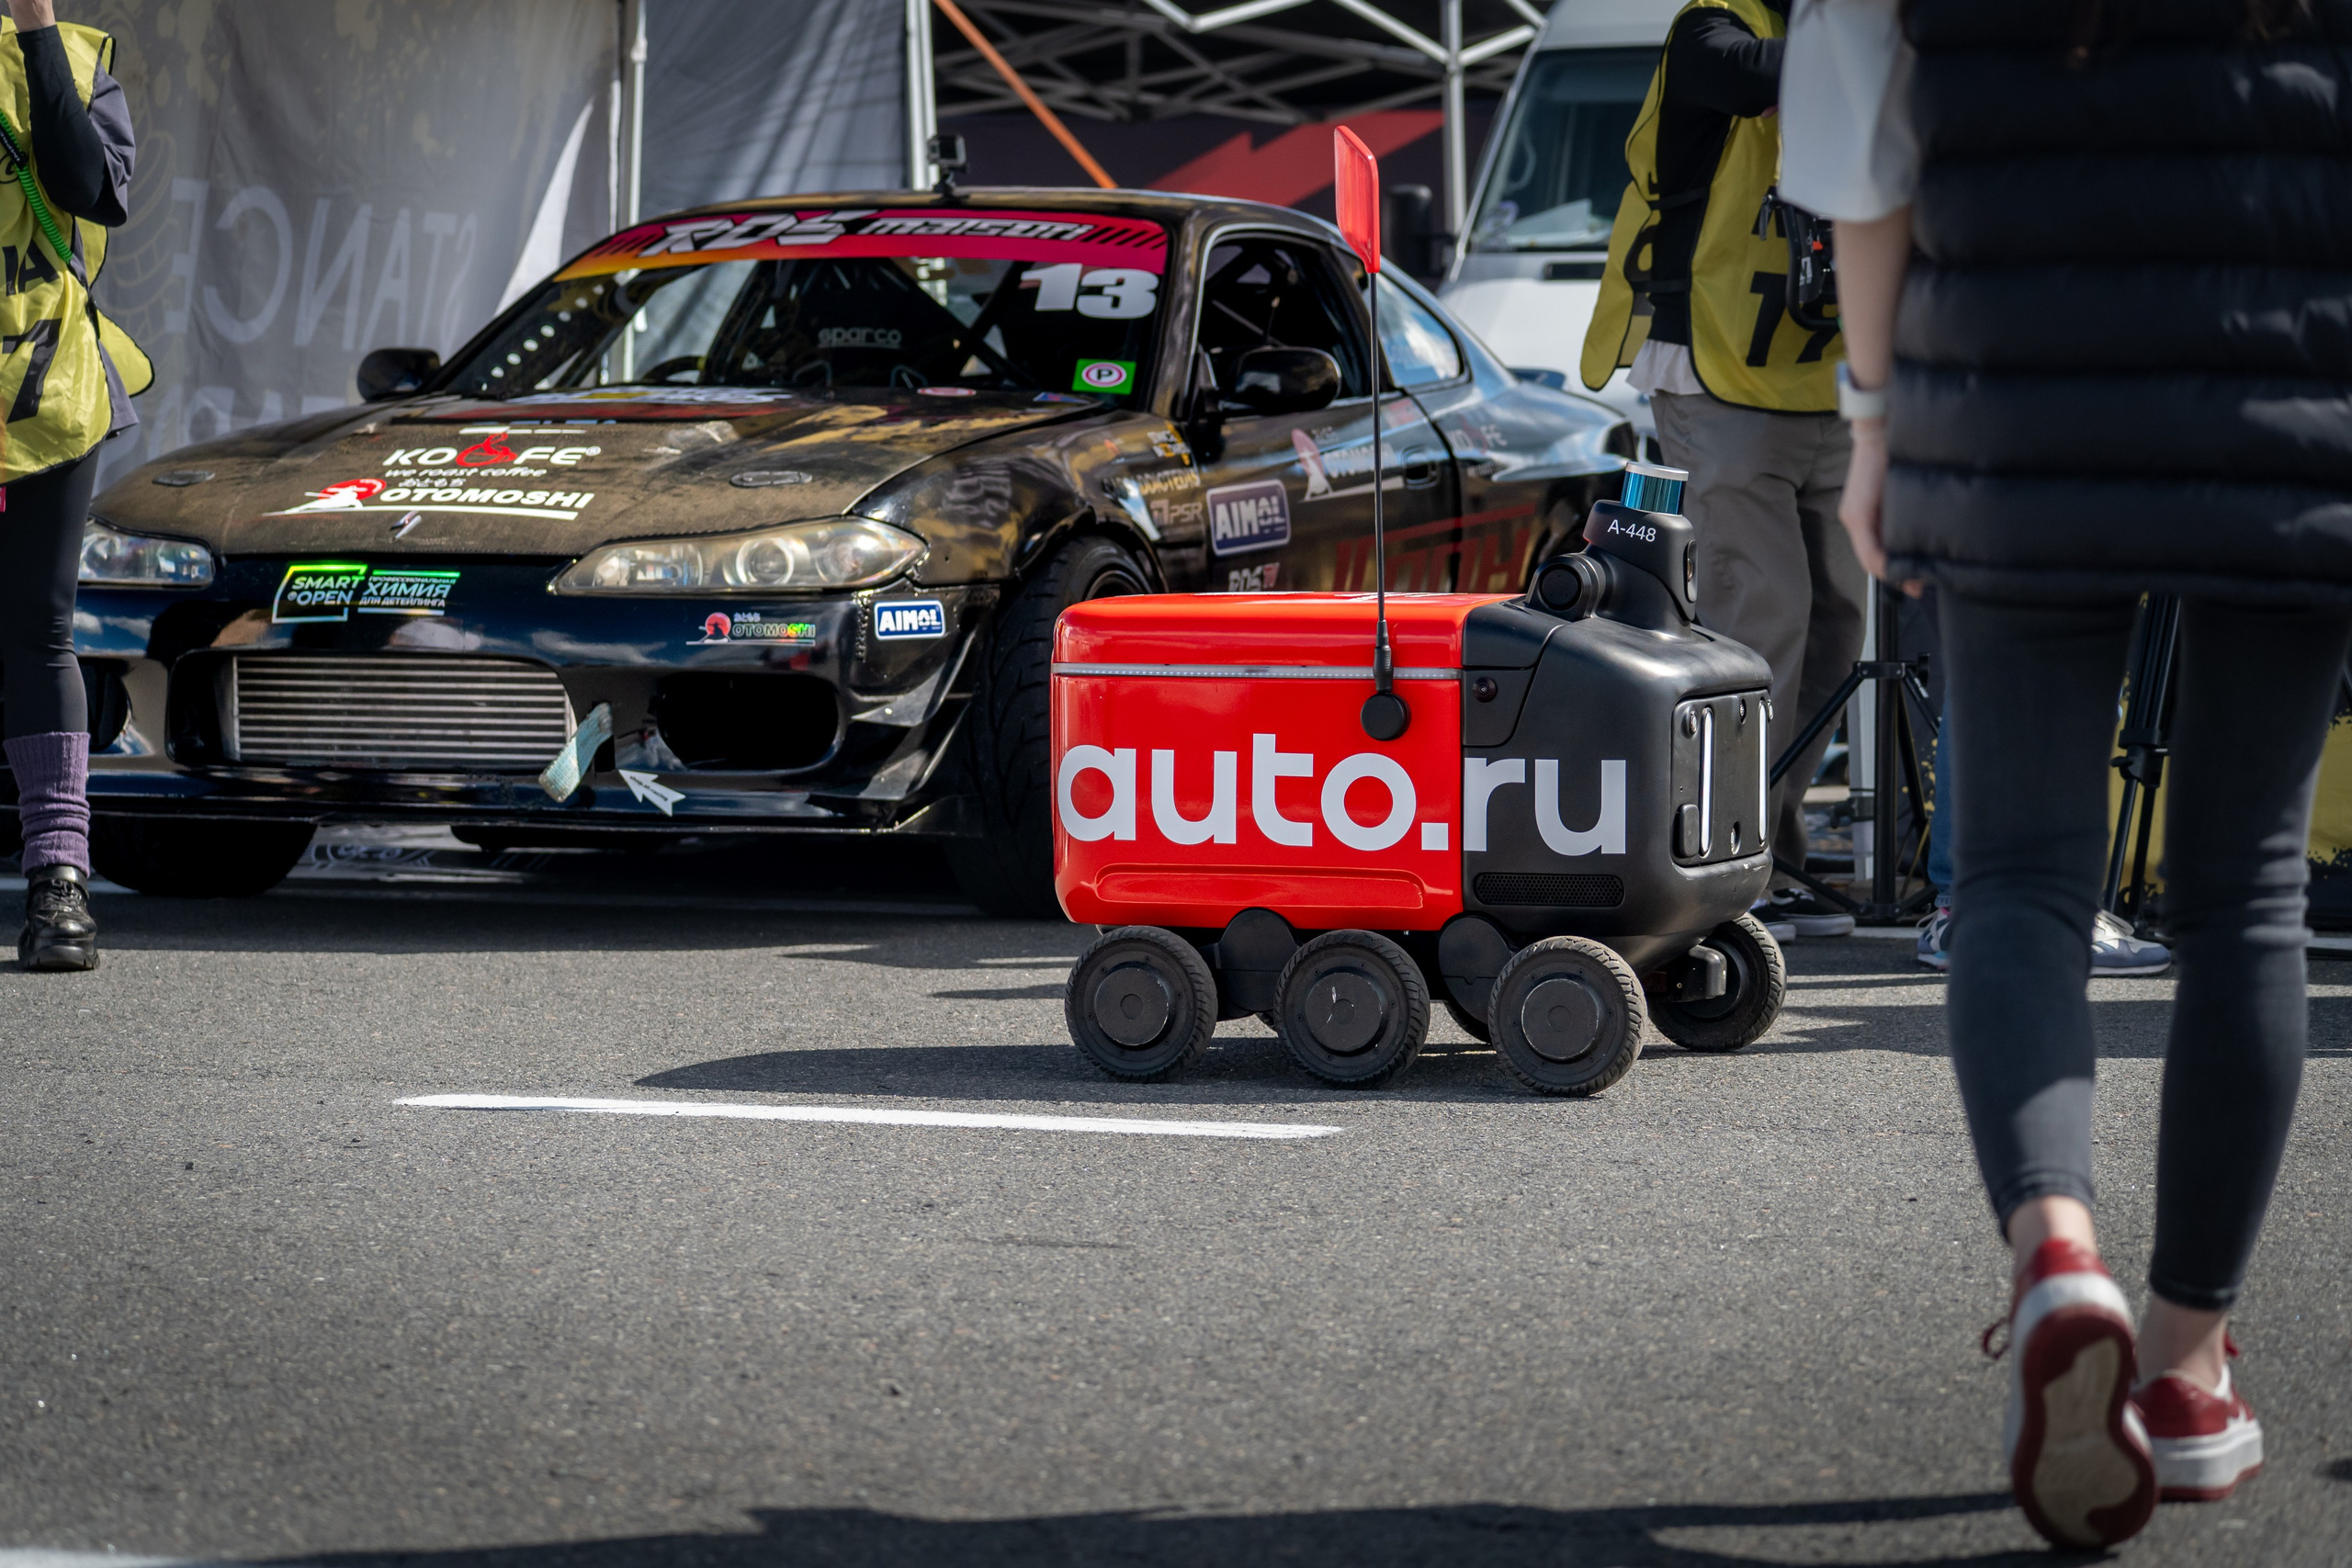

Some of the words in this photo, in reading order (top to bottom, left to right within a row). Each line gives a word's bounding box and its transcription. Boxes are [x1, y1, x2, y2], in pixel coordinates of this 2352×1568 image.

[638, 210, 878, 257] RDS
[1021, 263, 1159, 319] 13
[818, 327, 902, 347] sparco
[419, 467, 479, 478] roast
[481, 467, 548, 478] coffee
[379, 488, 594, 509] OTOMOSHI
[1216, 495, 1284, 540] AIMOL
[1607, 519, 1657, 542] A-448
[291, 575, 365, 590] SMART
[362, 582, 451, 598] ХИМИЯ
[359, 596, 380, 604] ДЛЯ
[381, 597, 446, 607] ДЕТЕЙЛИНГА
[732, 623, 816, 638] OTOMOSHI
[878, 608, 941, 632] AIMOL
[1057, 733, 1626, 856] auto.ru
